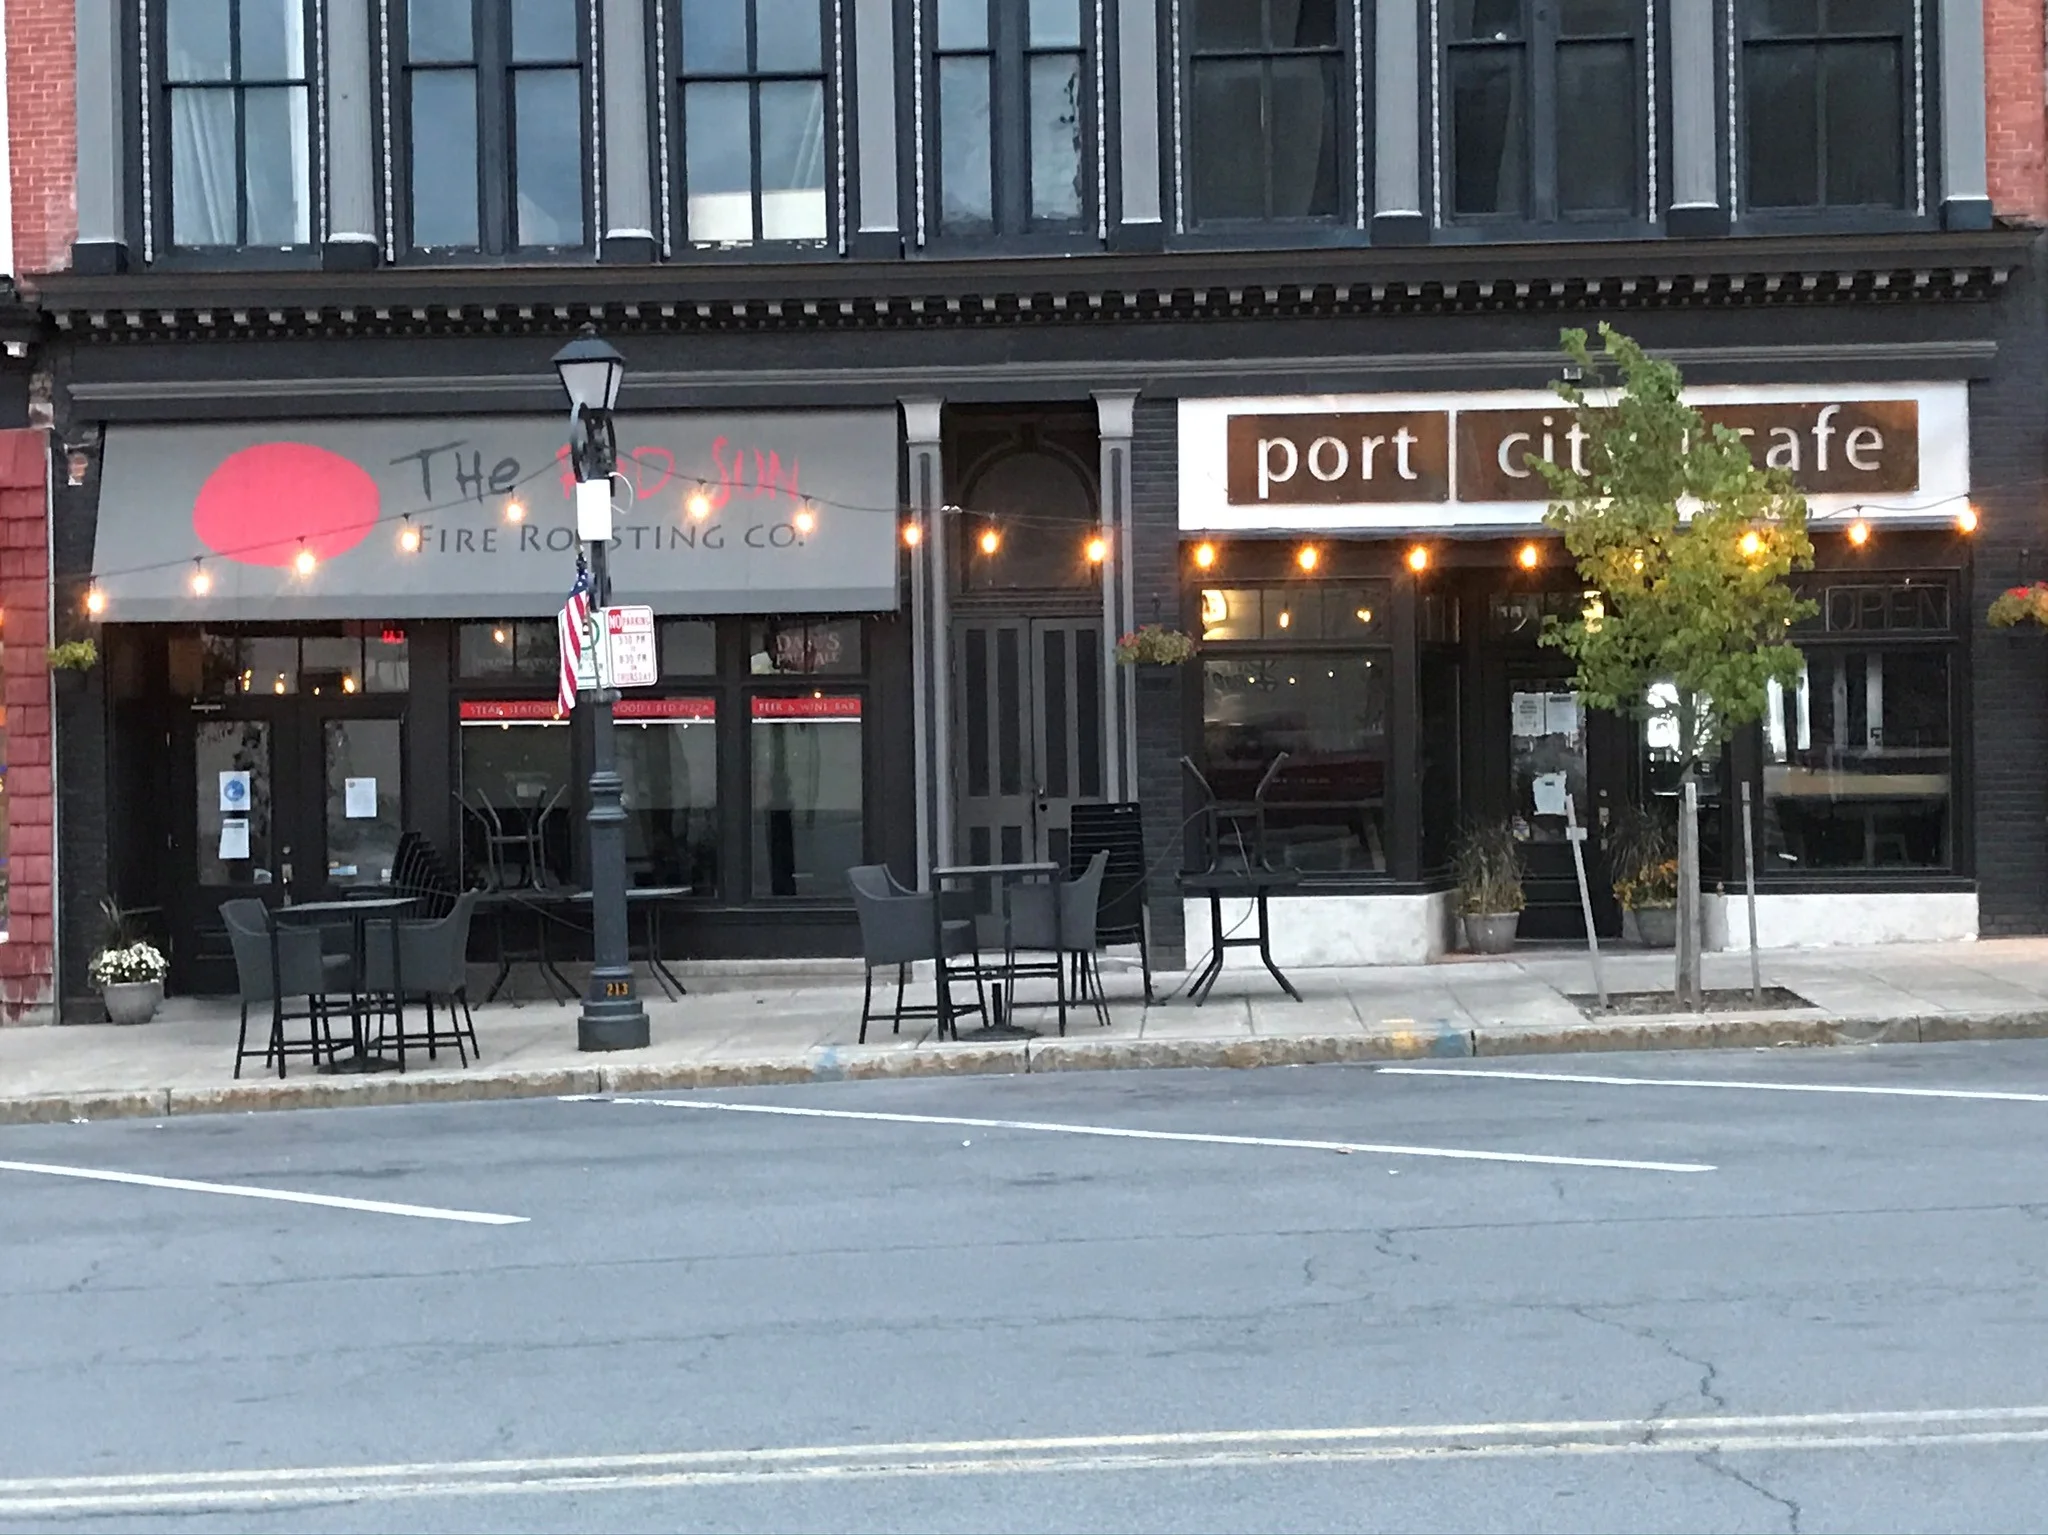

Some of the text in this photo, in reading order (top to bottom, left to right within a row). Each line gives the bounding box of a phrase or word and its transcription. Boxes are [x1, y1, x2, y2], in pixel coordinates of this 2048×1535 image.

[1256, 404, 1886, 498] port cit afe
[417, 522, 806, 553] FIRE ROSTING CO.
[1829, 587, 1948, 631] OPEN
[609, 614, 651, 629] NO PARKING
[617, 672, 652, 682] THURSDAY
[679, 703, 709, 713] PIZZA
[758, 703, 783, 712] BEER
[800, 702, 828, 712] WINE
[834, 702, 855, 711] BAR
